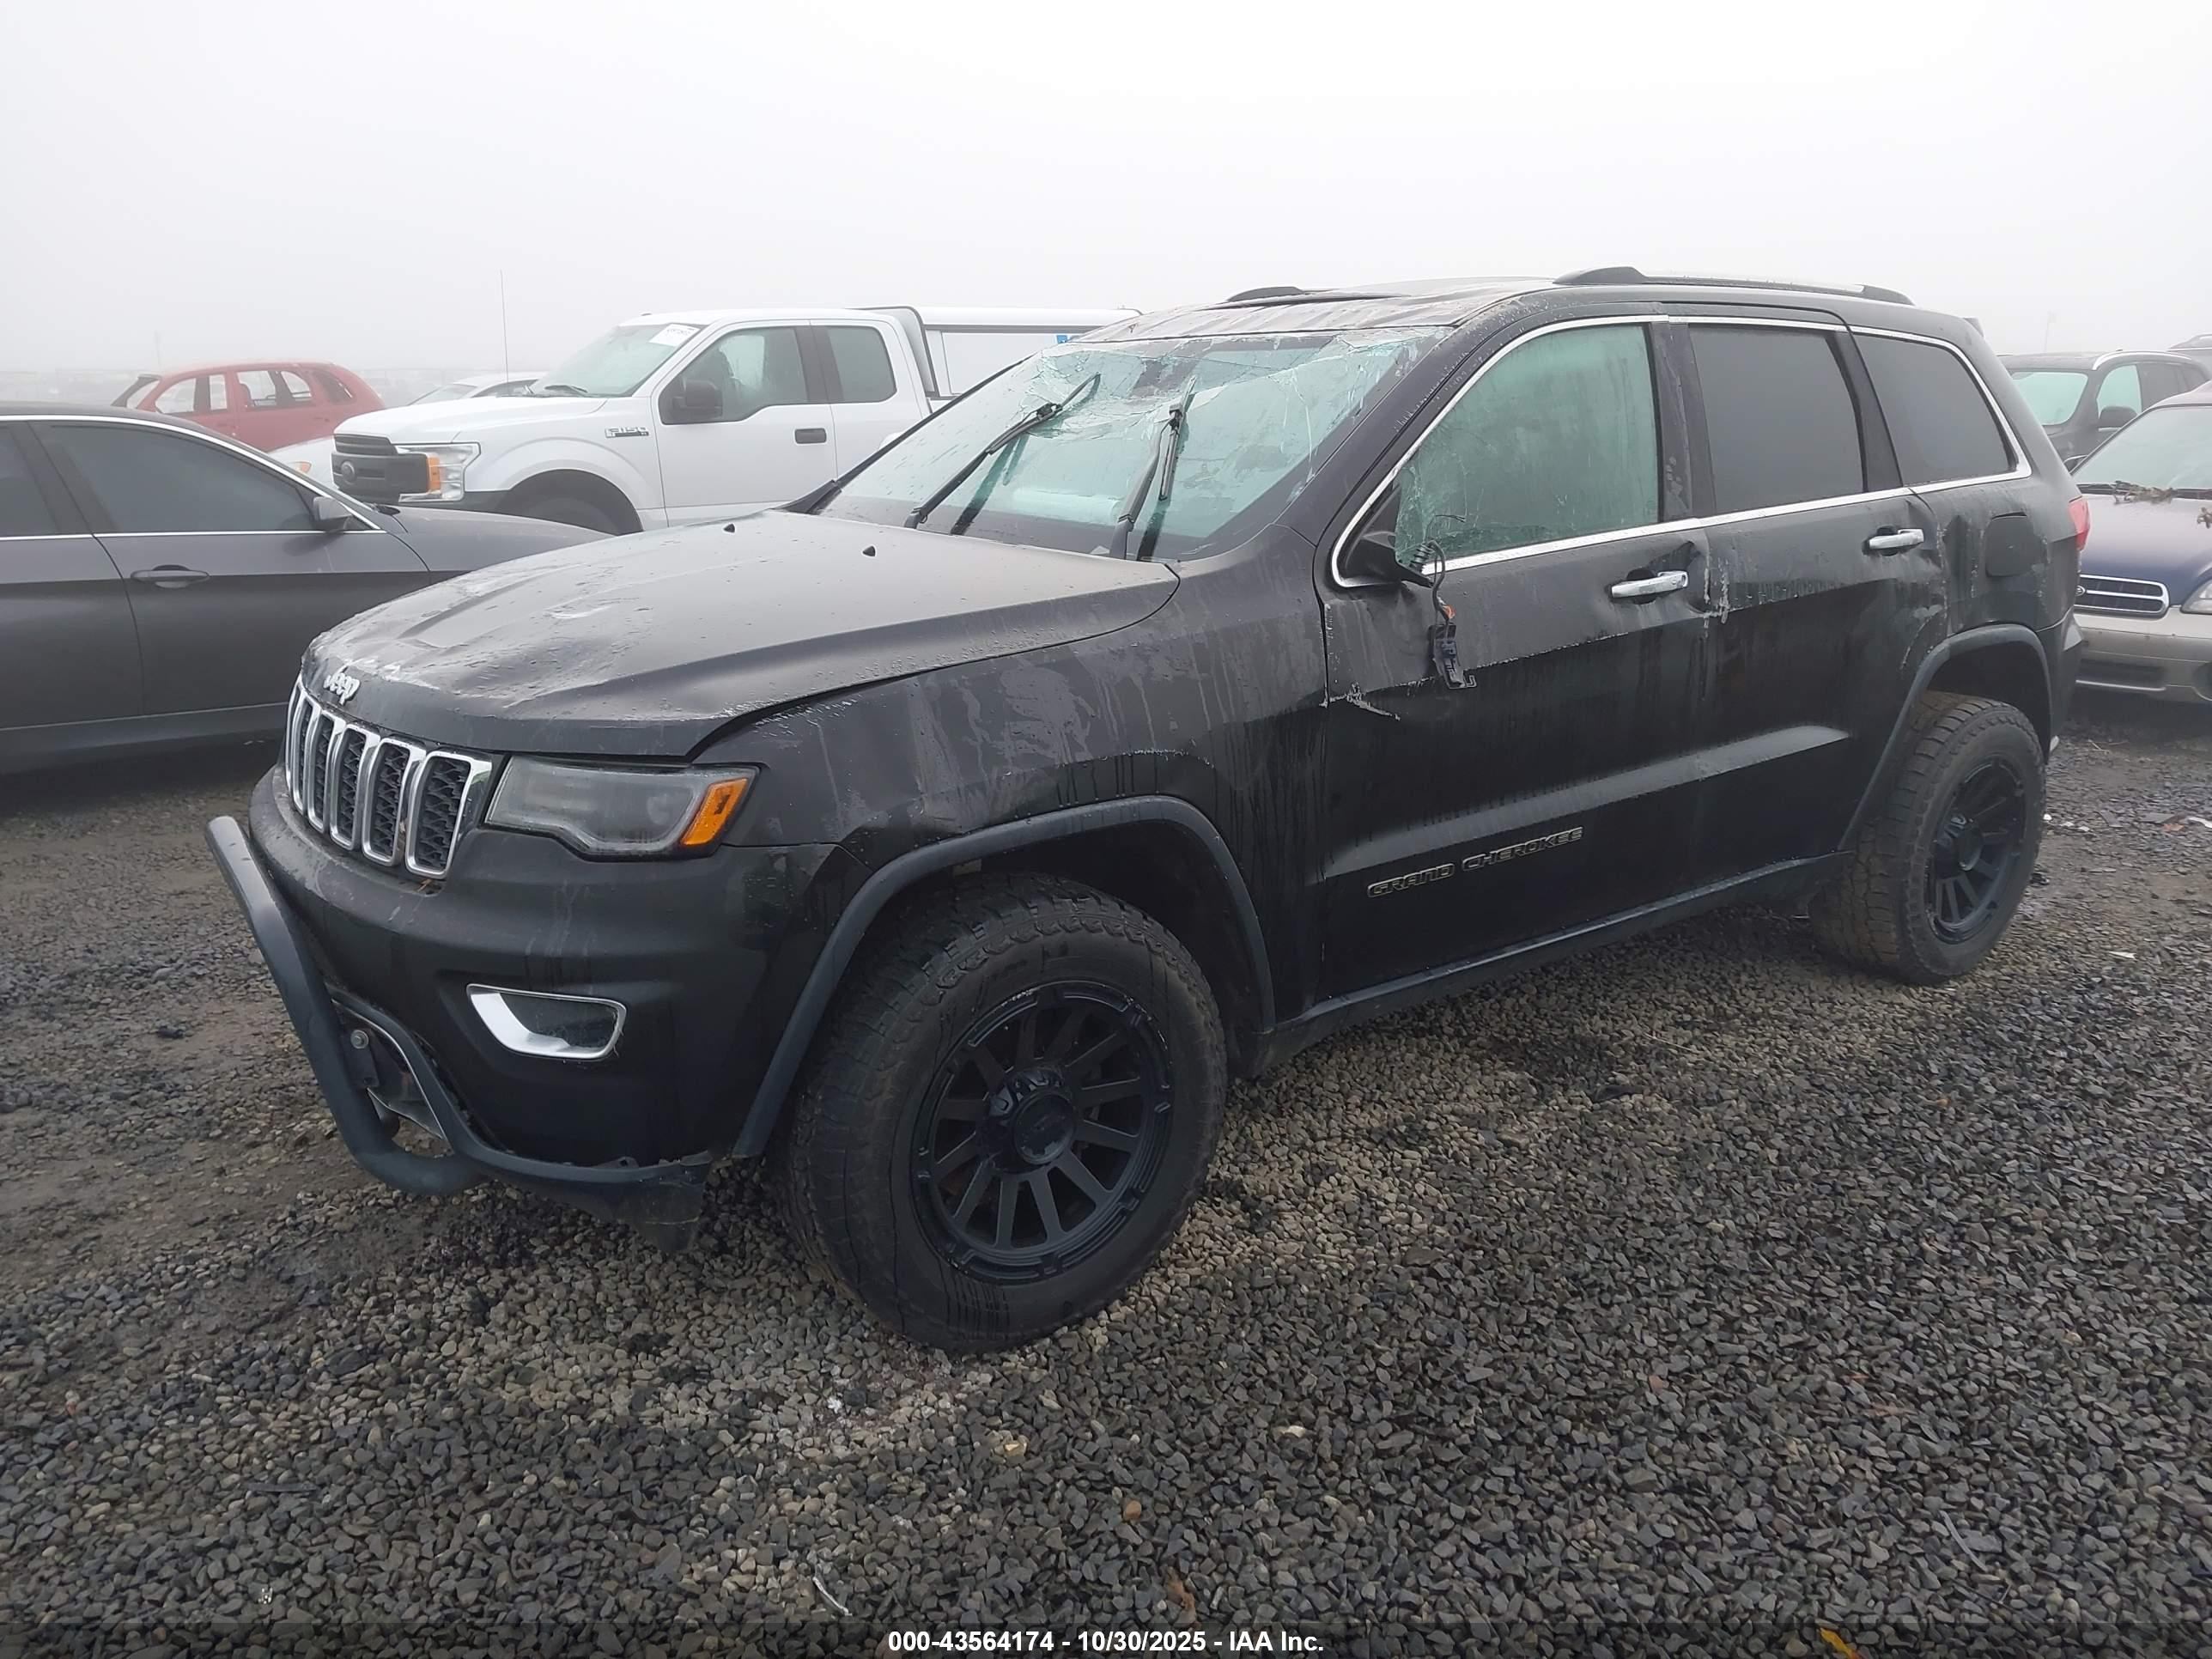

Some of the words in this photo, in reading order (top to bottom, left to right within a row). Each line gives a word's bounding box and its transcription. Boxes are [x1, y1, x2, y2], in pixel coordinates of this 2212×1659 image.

[323, 668, 361, 706] Jeep
[1367, 863, 1455, 897] GRAND
[1462, 826, 1584, 872] CHEROKEE
